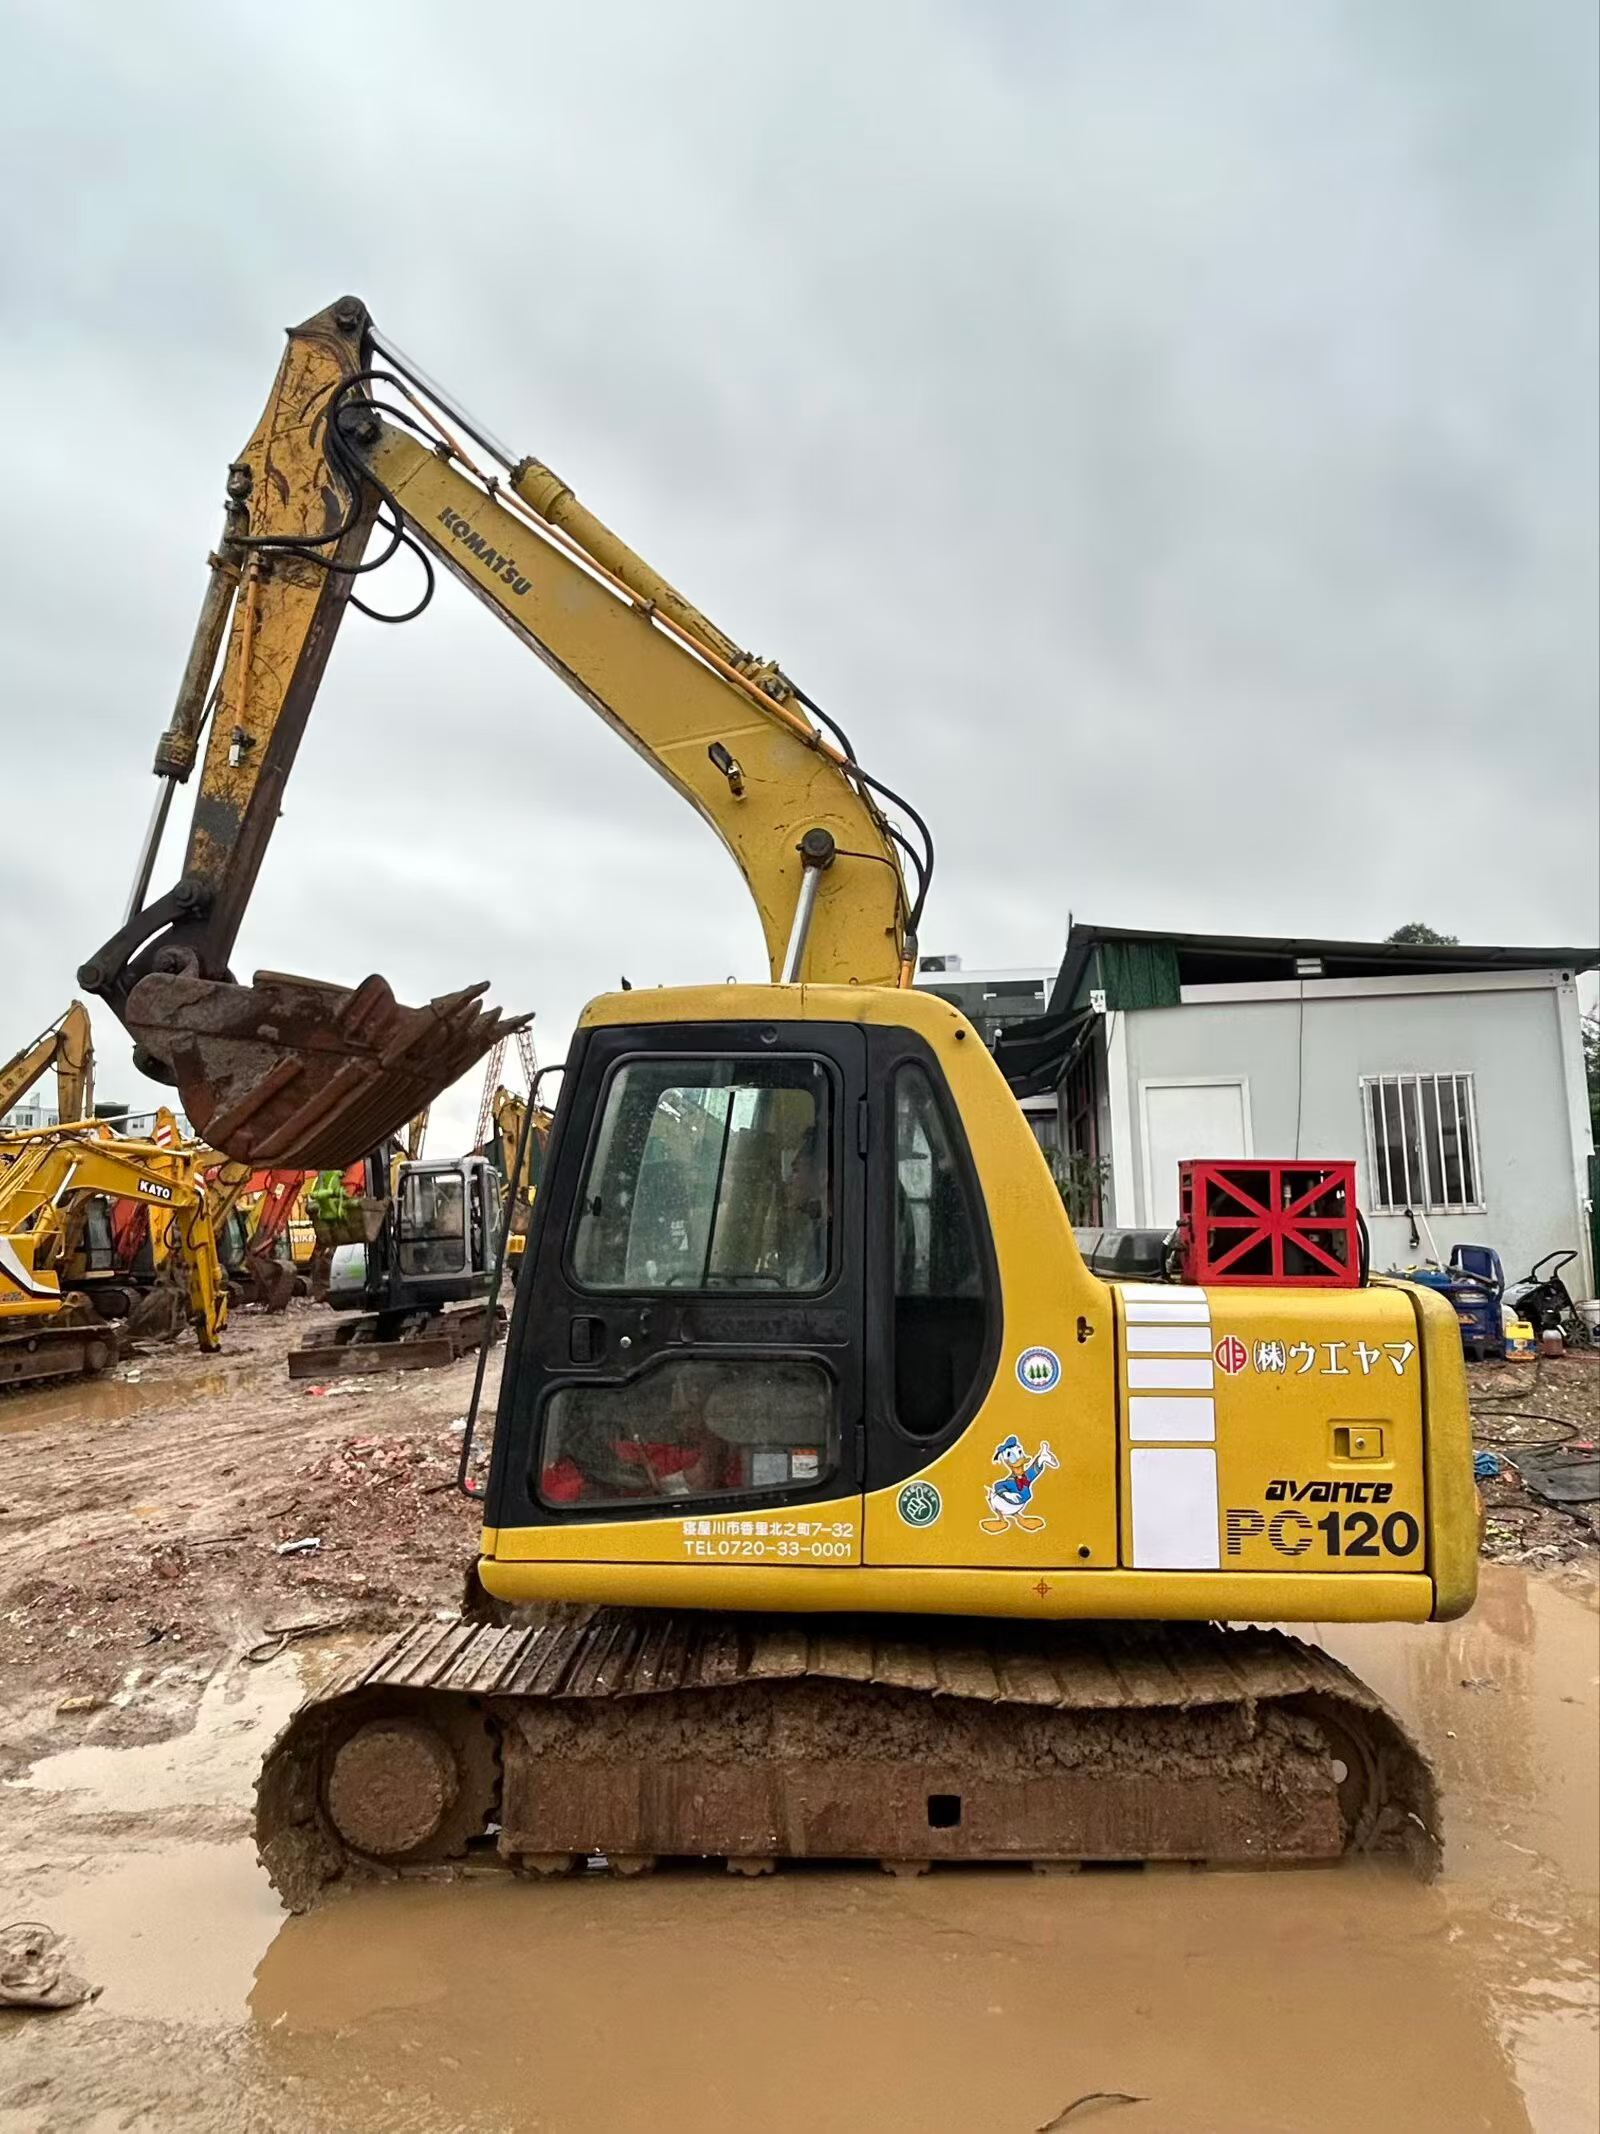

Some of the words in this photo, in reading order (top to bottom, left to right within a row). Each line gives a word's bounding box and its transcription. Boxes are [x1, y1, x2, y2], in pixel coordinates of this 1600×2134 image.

[437, 507, 533, 595] KOMATSU
[140, 1180, 170, 1199] KATO
[1265, 1480, 1393, 1503] avance
[1226, 1509, 1420, 1556] PC120
